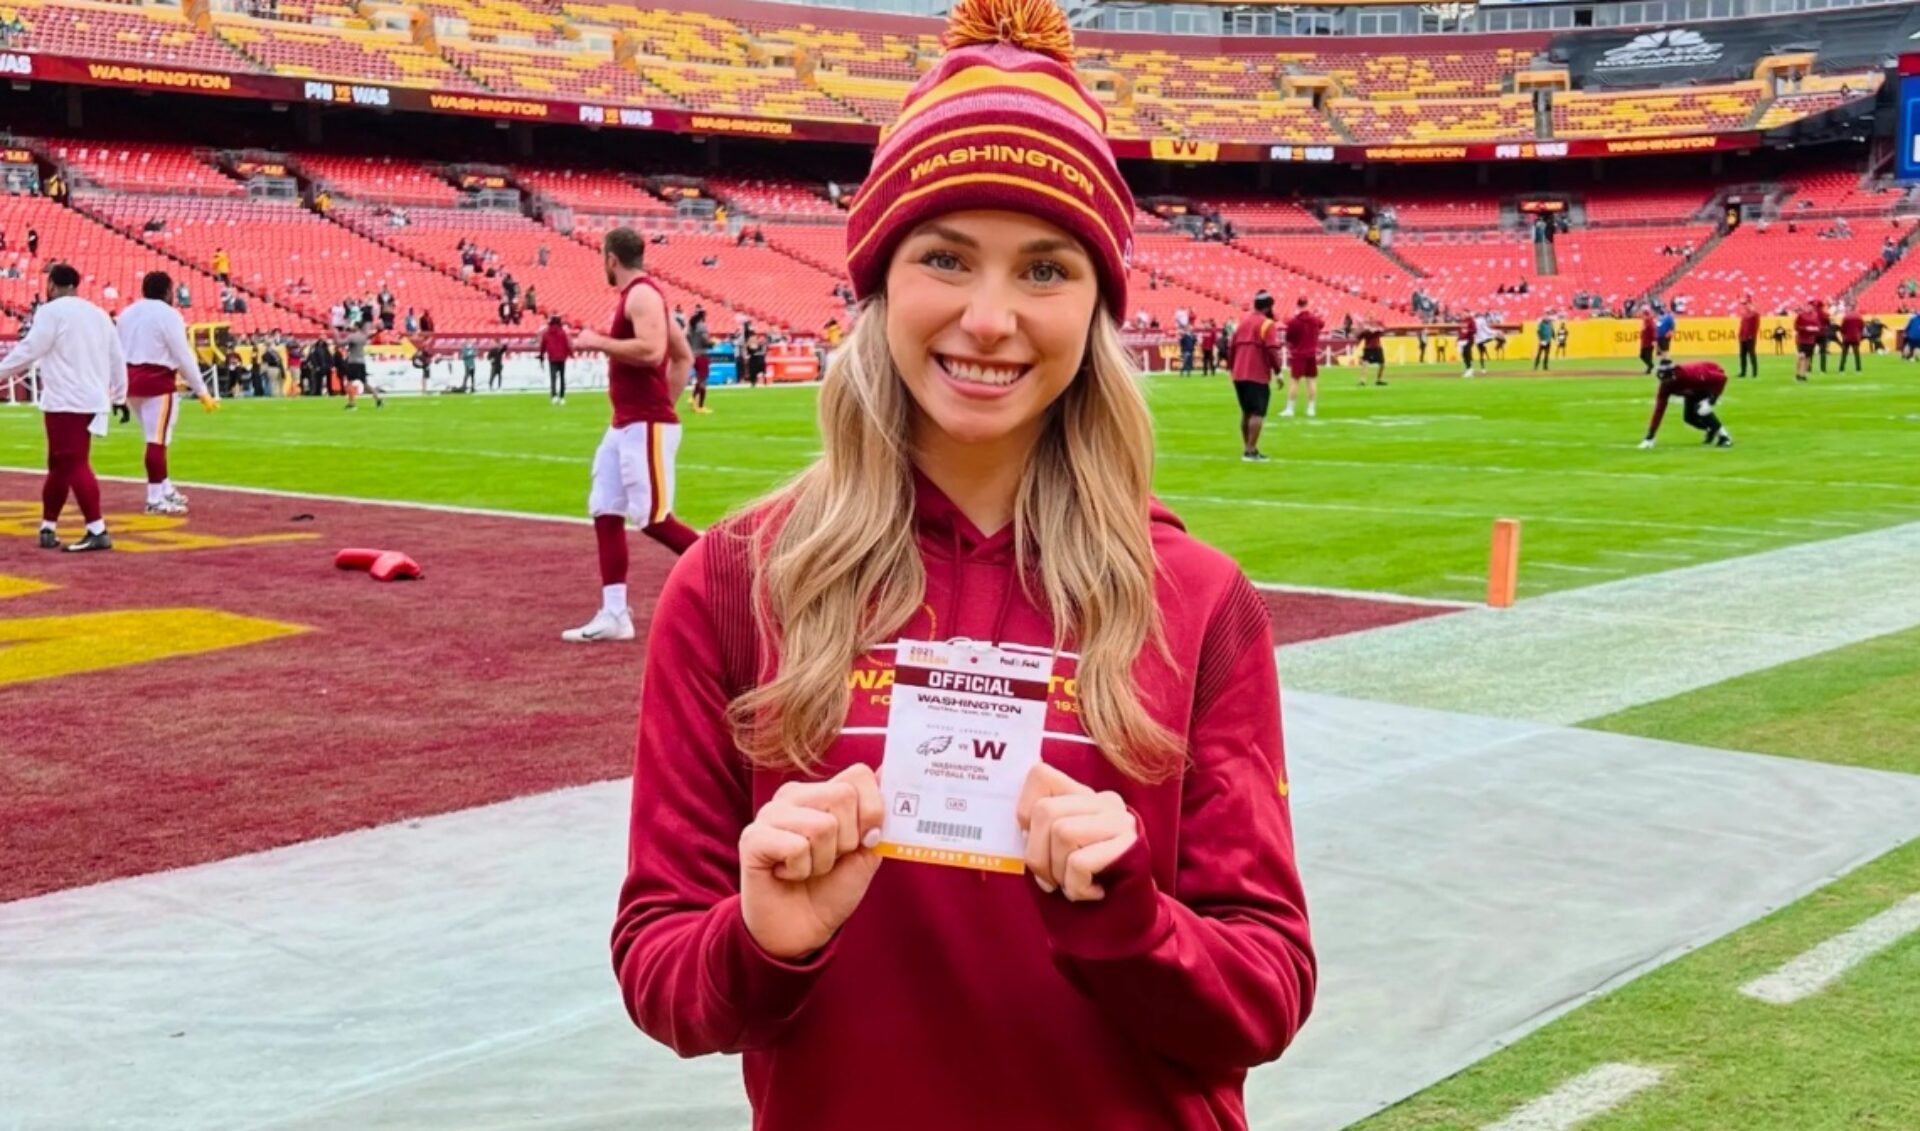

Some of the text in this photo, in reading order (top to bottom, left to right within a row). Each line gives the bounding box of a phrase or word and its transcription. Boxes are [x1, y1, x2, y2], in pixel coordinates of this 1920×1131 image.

[88, 64, 231, 90] WASHINGTON
[305, 81, 333, 101] PHI
[352, 86, 389, 105] WAS
[430, 95, 547, 116] WASHINGTON
[620, 108, 653, 126] WAS
[691, 117, 792, 134] WASHINGTON
[1365, 146, 1467, 158] WASHINGTON
[1607, 136, 1717, 152] WASHINGTON
[910, 144, 1095, 196] WASHINGTON
[1673, 330, 1704, 342] OWL
[1708, 328, 1794, 342] CHAIOS
[928, 670, 1015, 696] OFFICIAL
[917, 693, 1022, 714] WASHINGTON
[972, 738, 1007, 761] W
[900, 800, 911, 813] A
